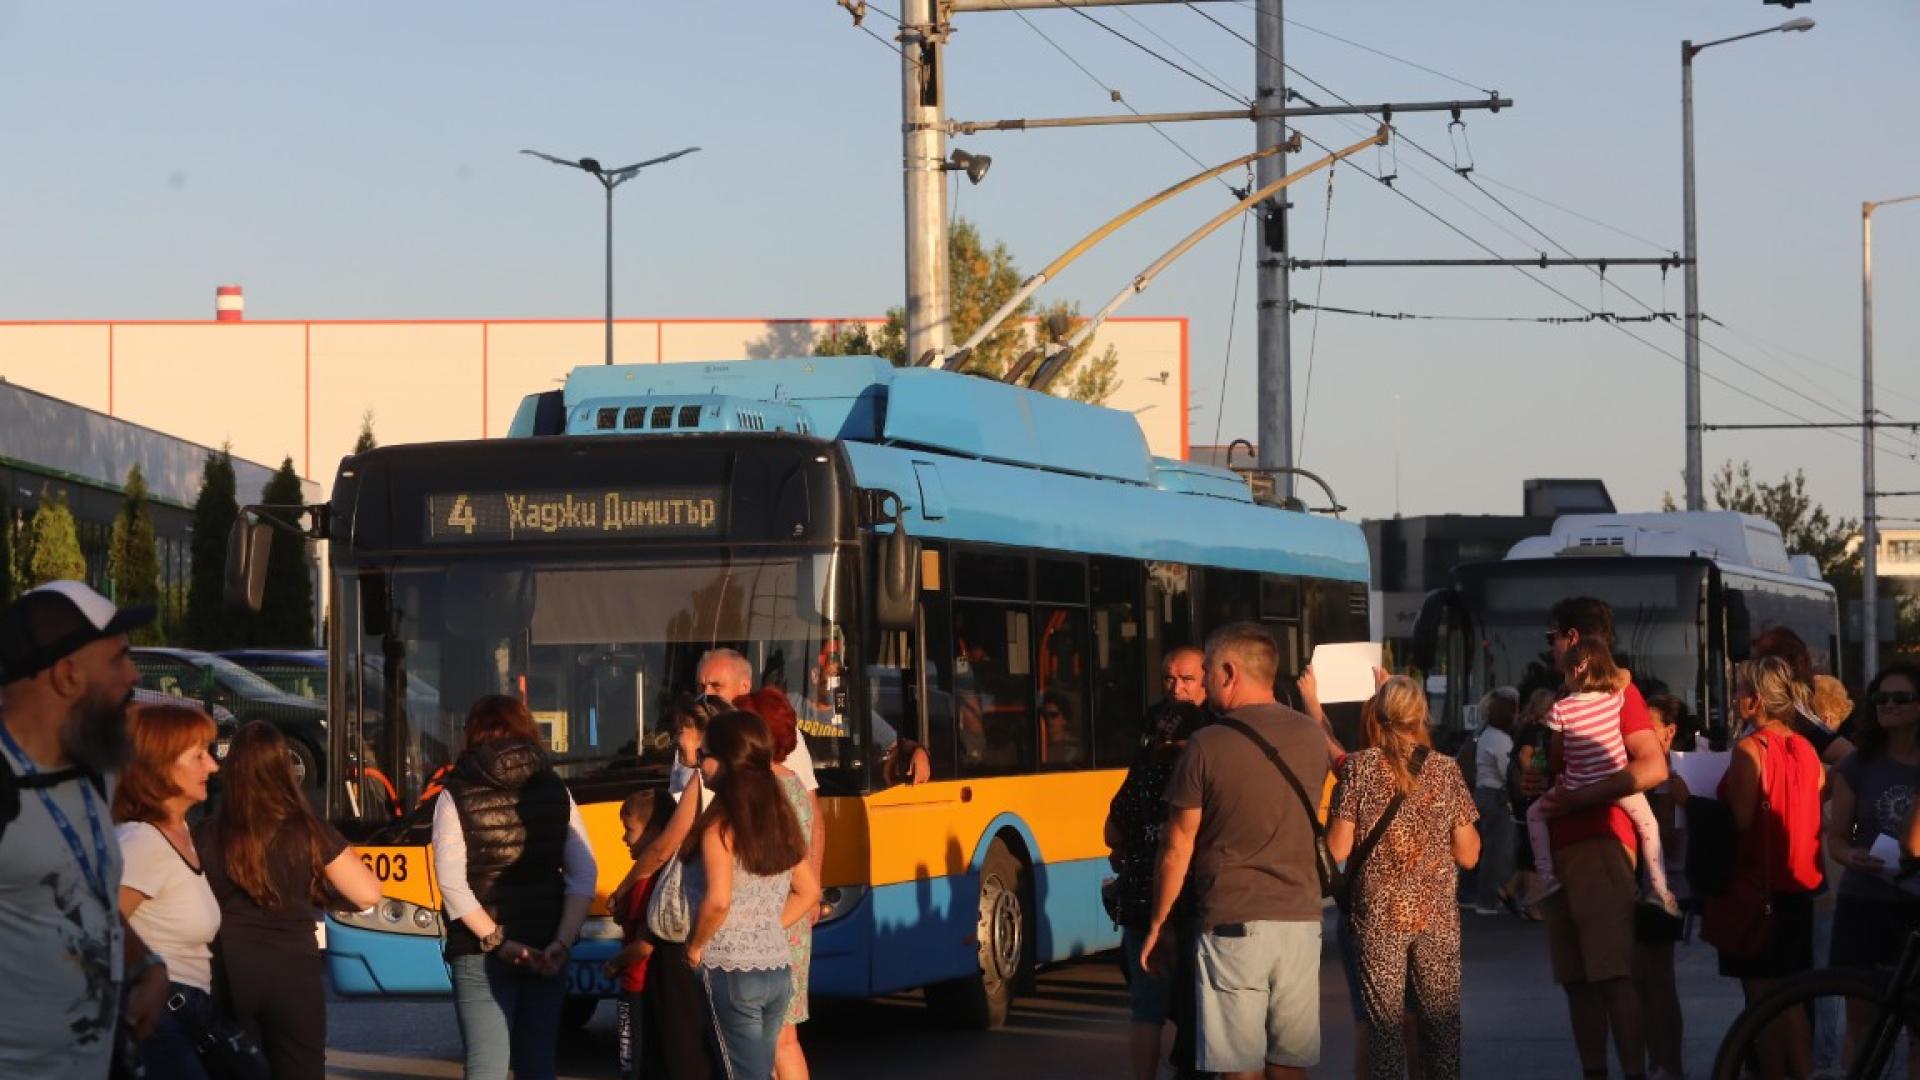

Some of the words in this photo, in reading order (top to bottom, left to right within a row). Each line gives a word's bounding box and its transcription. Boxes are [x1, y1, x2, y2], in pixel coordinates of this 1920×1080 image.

[447, 494, 477, 535] 4
[507, 493, 596, 533] Хаджи
[603, 493, 715, 531] Димитър
[568, 964, 617, 992] 03
